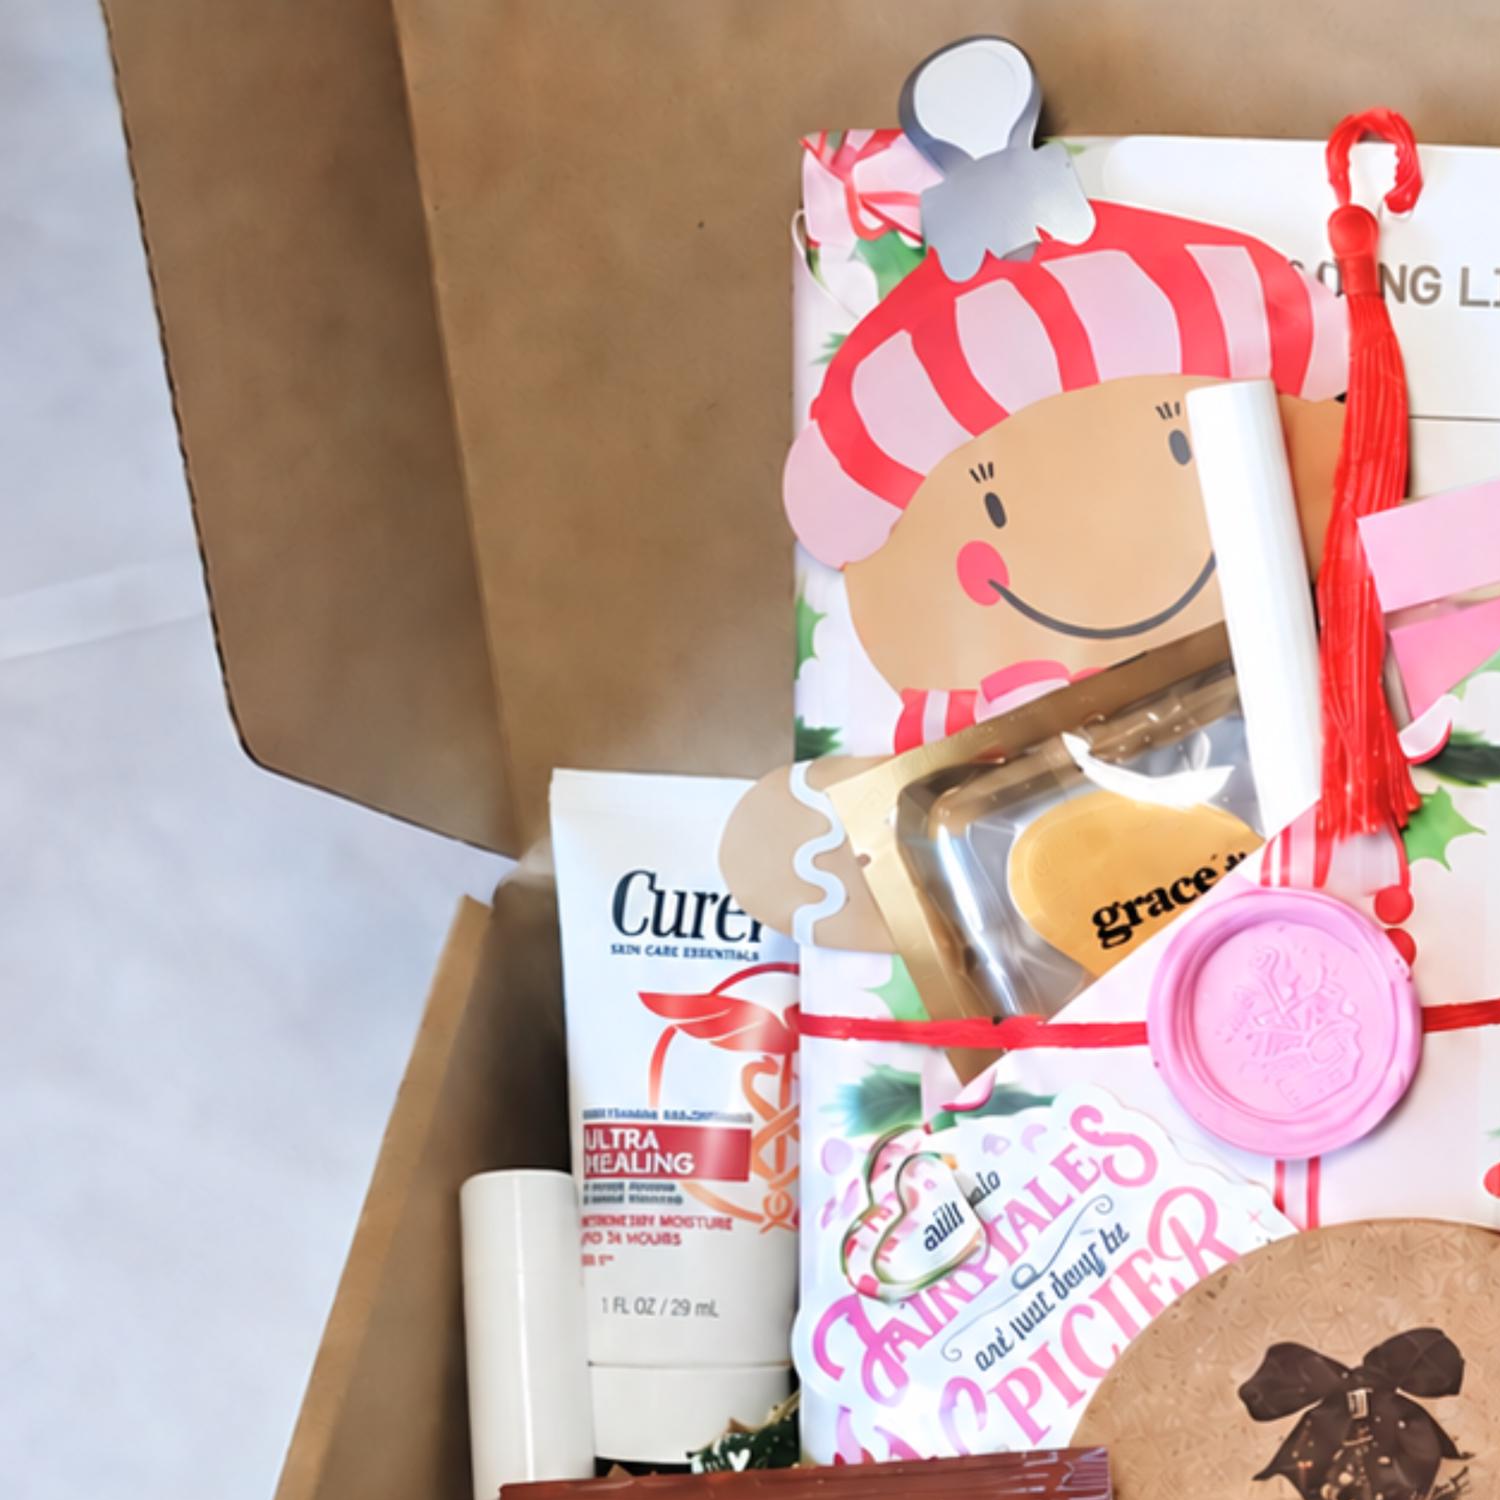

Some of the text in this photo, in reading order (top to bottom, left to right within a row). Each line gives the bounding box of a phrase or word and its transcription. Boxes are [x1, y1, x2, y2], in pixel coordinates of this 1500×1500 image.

[1092, 866, 1217, 949] grace
[645, 944, 678, 957] CARE
[585, 1128, 659, 1150] ULTRA
[584, 1152, 695, 1175] HEALING
[633, 1296, 656, 1316] OZ
[671, 1297, 691, 1316] 29
